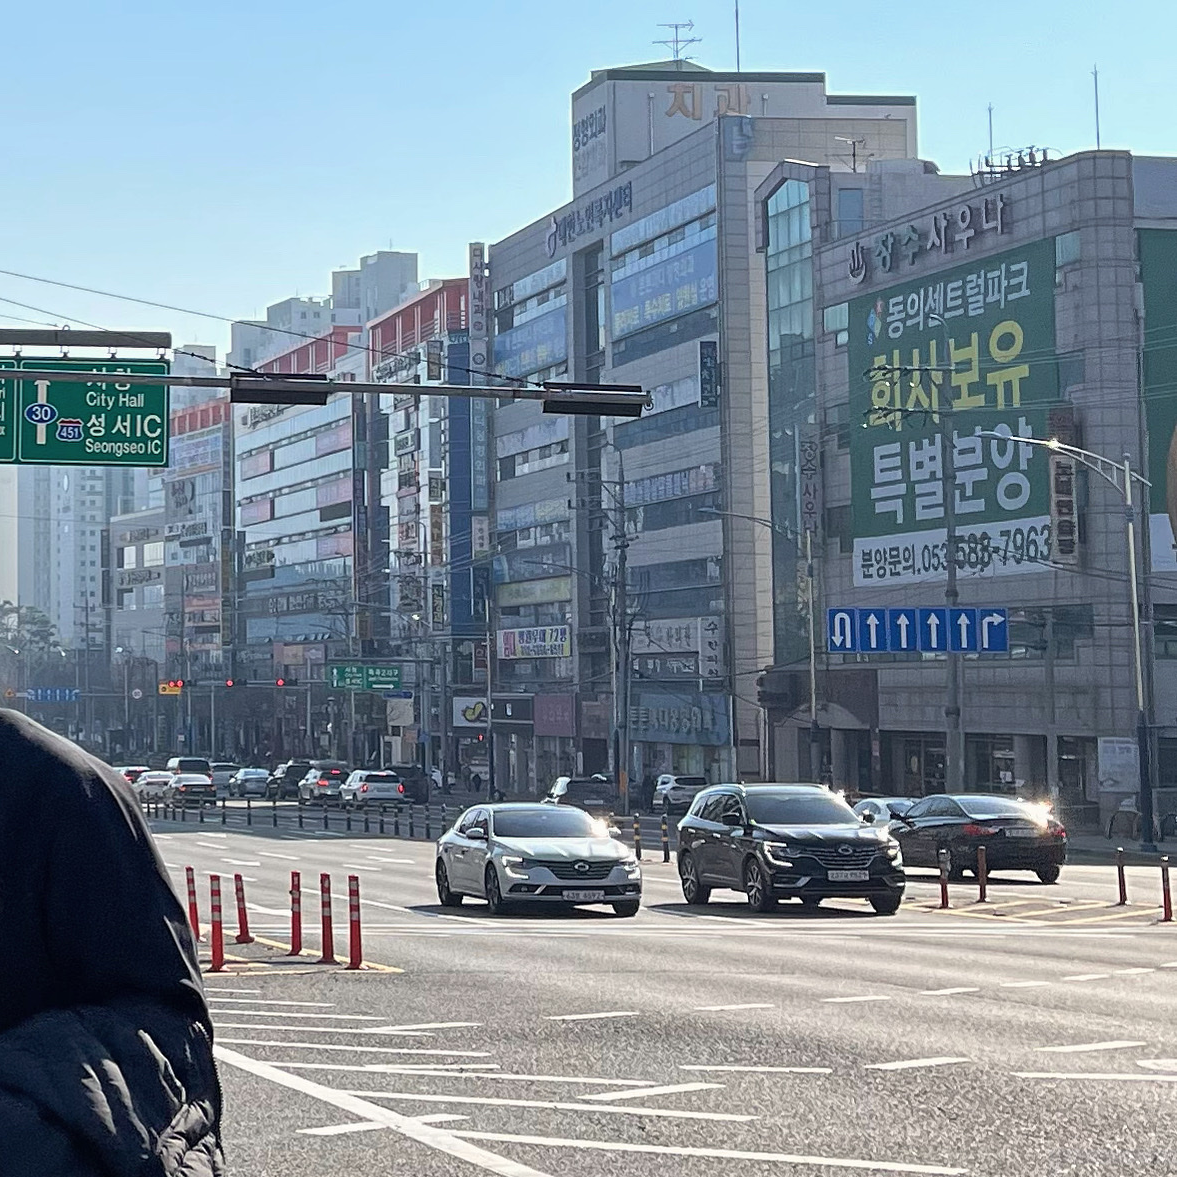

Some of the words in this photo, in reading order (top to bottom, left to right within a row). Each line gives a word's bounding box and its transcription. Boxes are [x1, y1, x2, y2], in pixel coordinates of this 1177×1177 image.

[886, 260, 1031, 339] 동의센트럴파크
[870, 319, 1030, 432] 회사보유
[31, 406, 51, 421] 30
[85, 391, 116, 410] City
[118, 393, 145, 407] Hall
[60, 428, 80, 438] 451
[85, 438, 145, 457] Seongseo
[147, 440, 162, 455] IC
[800, 440, 819, 538] 장수사우나
[870, 416, 1034, 525] 특별분양
